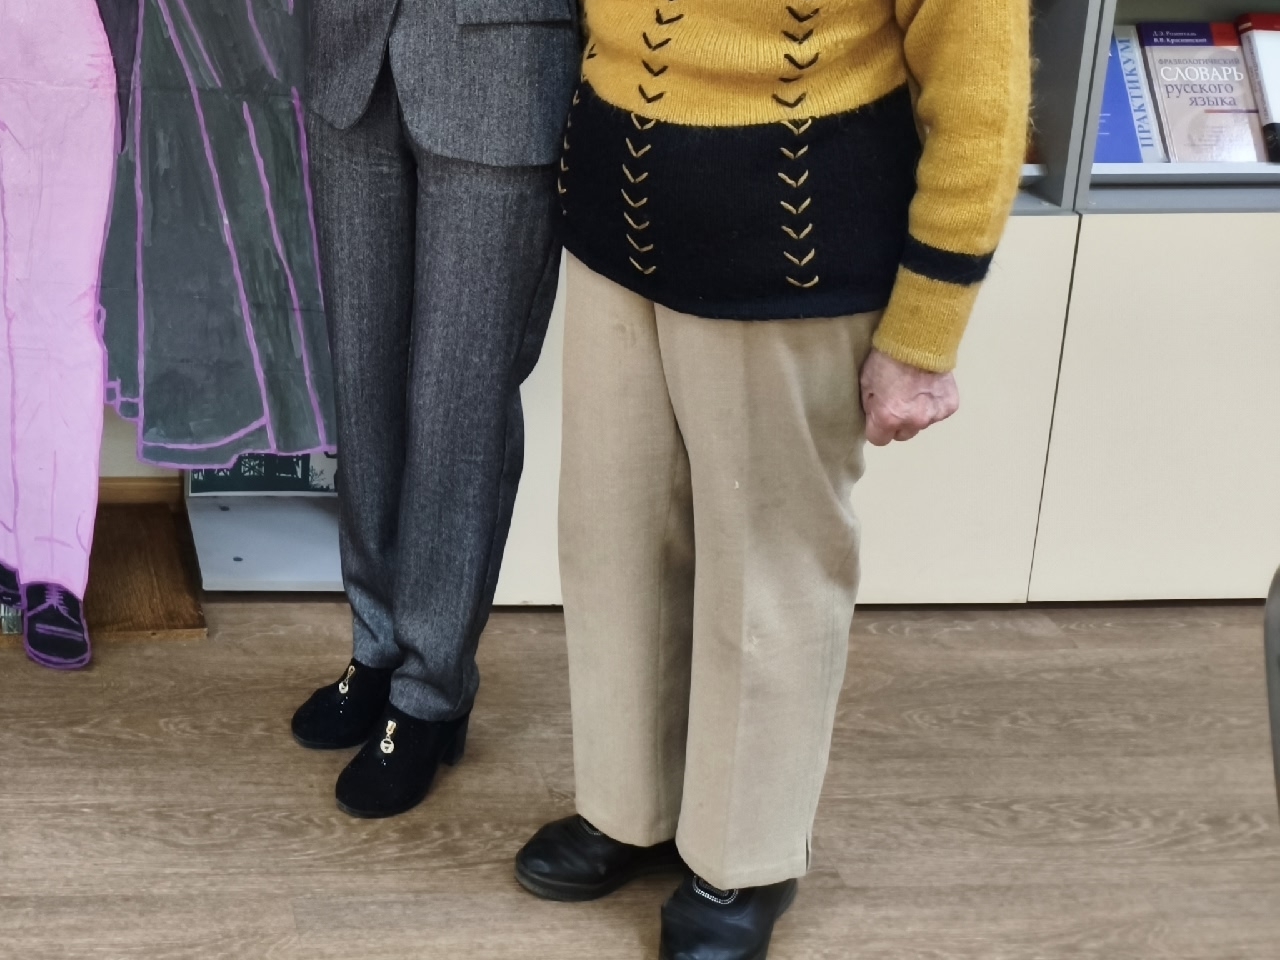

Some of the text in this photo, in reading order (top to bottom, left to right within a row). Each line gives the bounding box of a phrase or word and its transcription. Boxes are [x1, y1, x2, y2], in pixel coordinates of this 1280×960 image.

[1158, 57, 1240, 65] ФРАЗЕОЛОГИЧЕСКИЙ
[1160, 66, 1244, 81] СЛОВАРЬ
[1117, 39, 1154, 148] ПРАКТИКУМ
[1164, 83, 1234, 98] русского
[1189, 96, 1238, 106] языка
